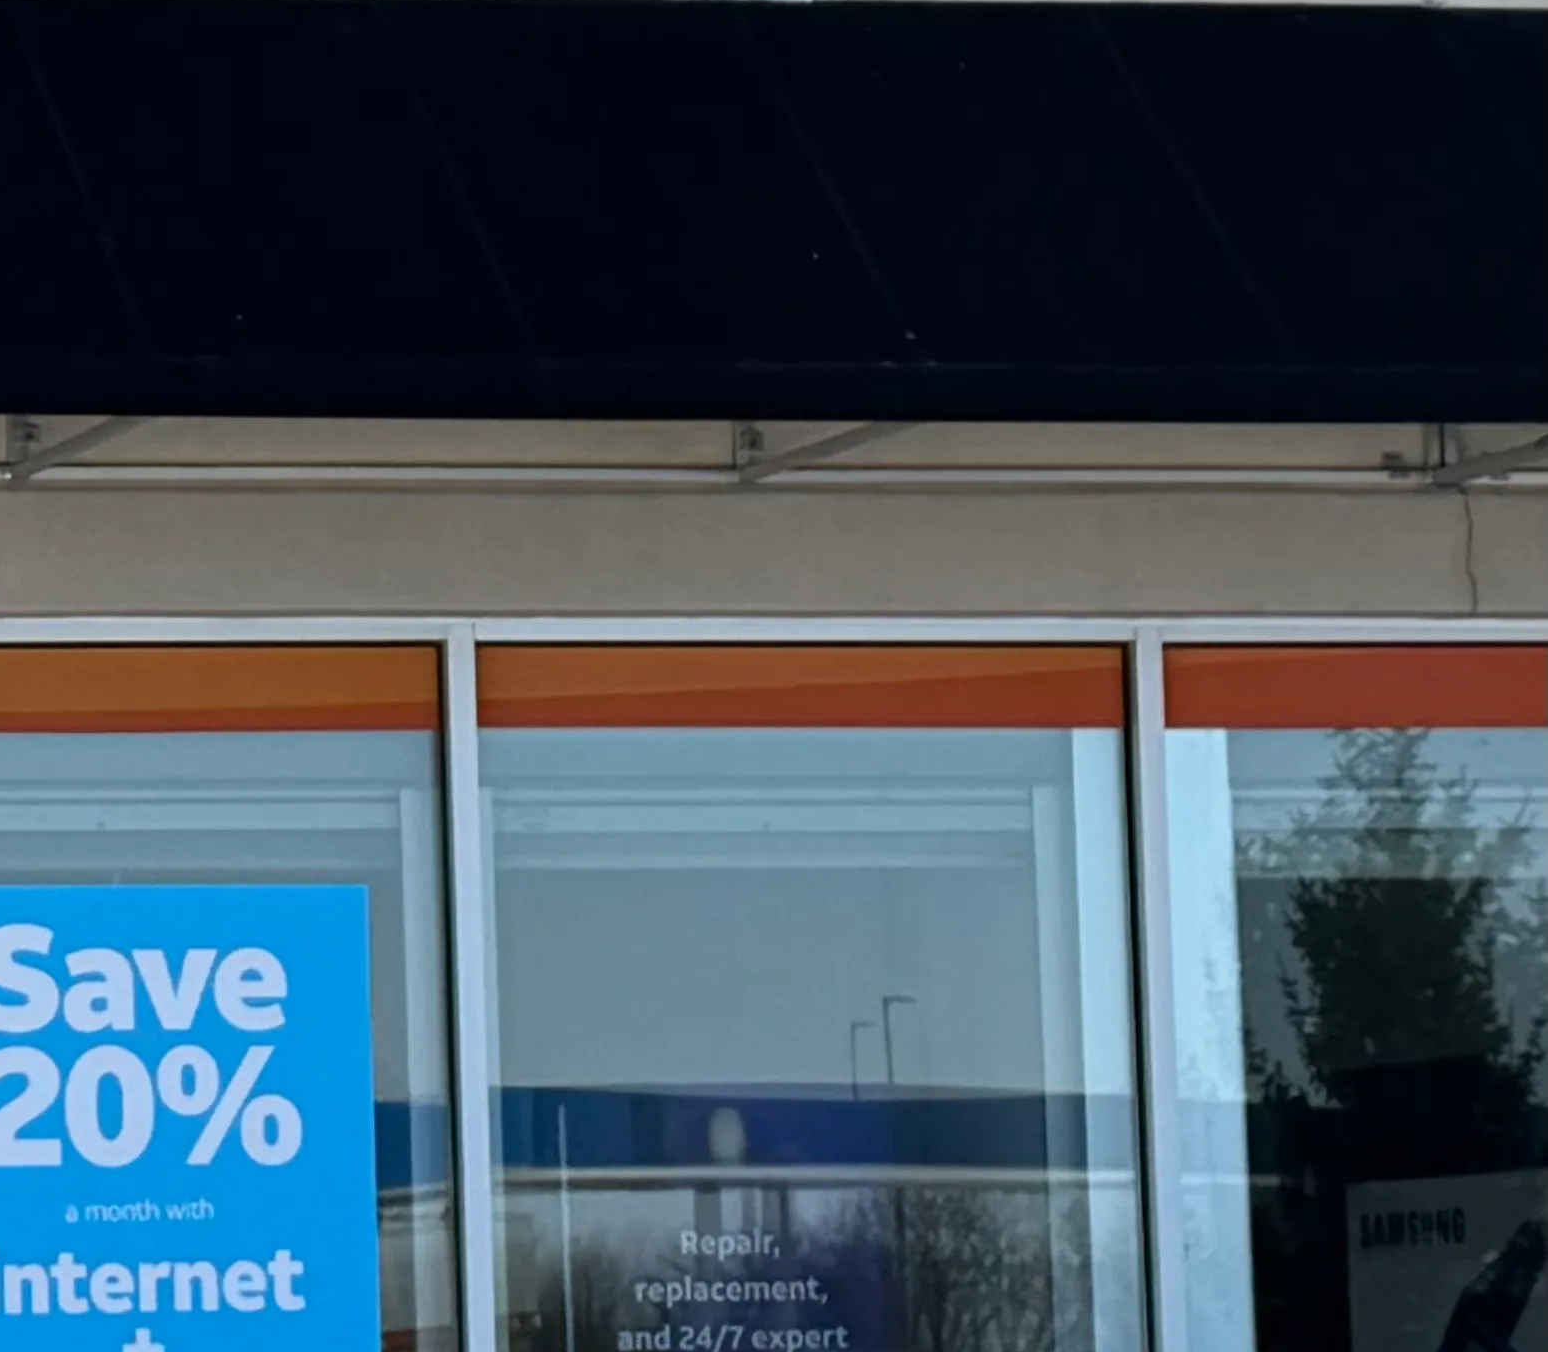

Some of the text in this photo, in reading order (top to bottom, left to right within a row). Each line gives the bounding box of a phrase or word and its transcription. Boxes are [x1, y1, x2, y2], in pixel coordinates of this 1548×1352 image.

[65, 1197, 215, 1224] a month with
[681, 1230, 780, 1259] Repair,
[635, 1277, 828, 1308] replacement,
[617, 1326, 671, 1351] and
